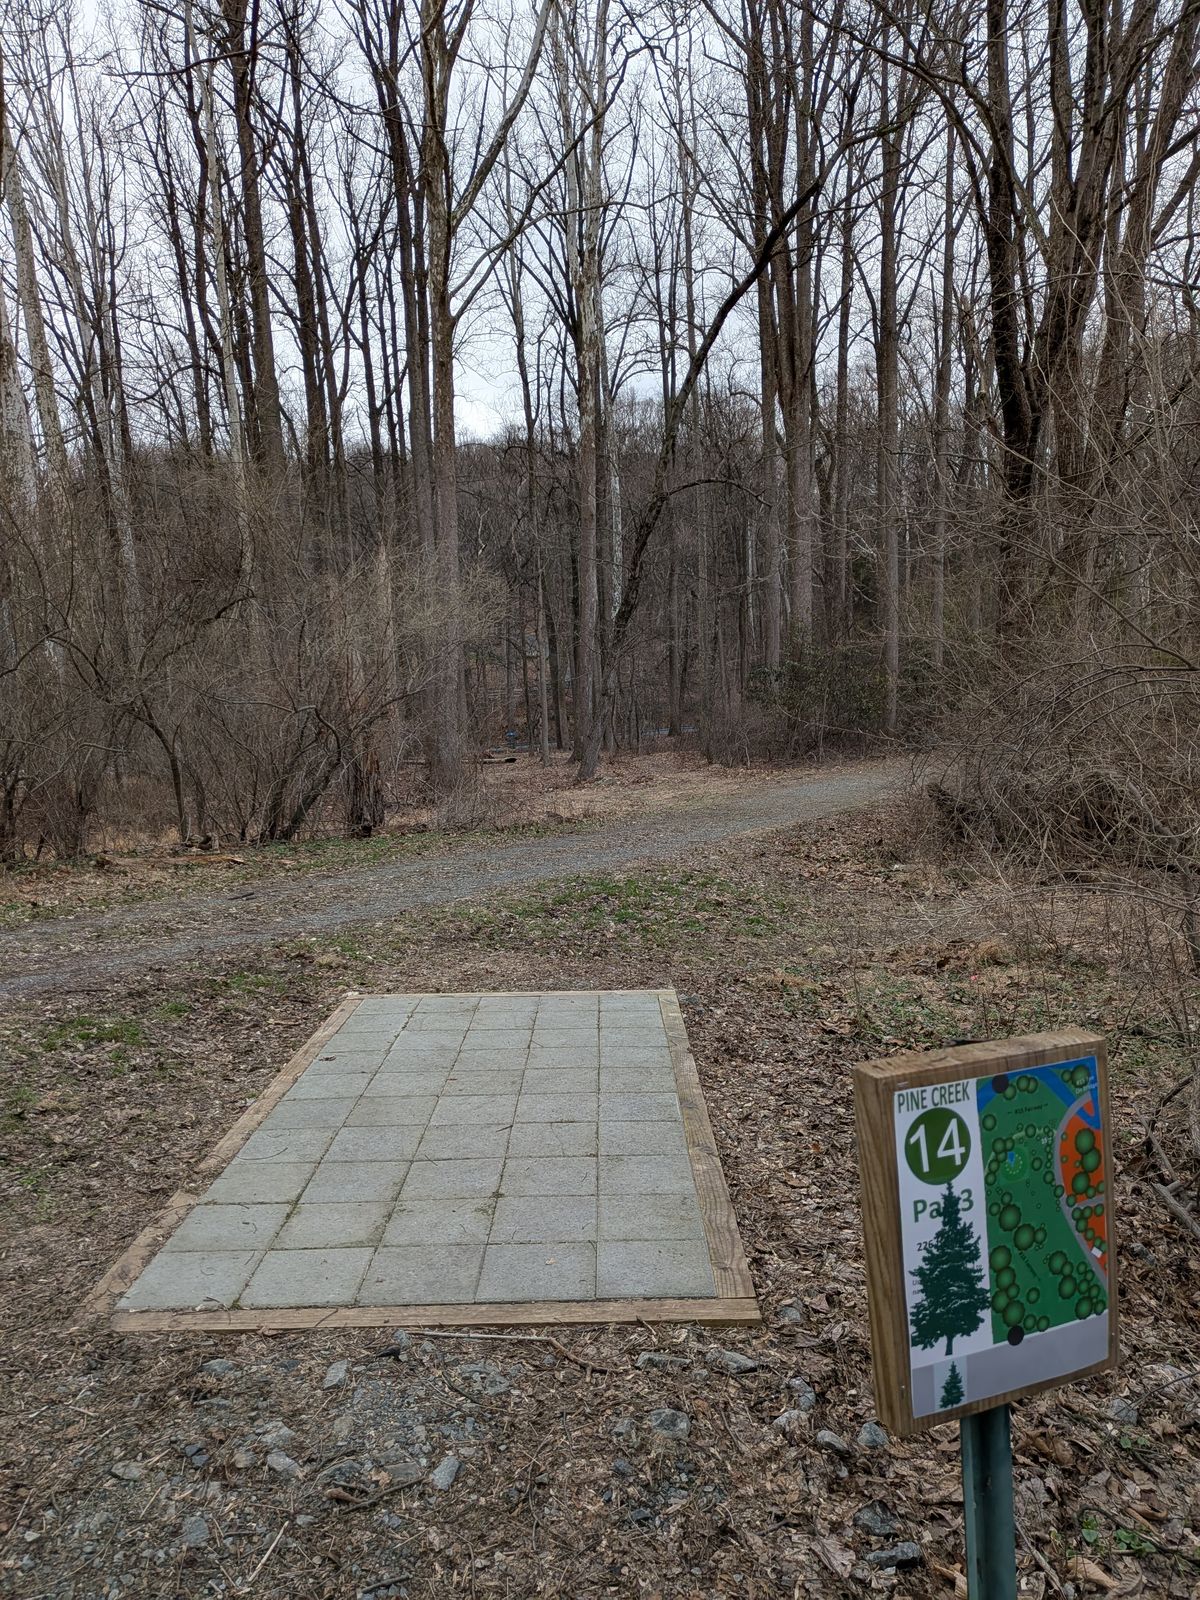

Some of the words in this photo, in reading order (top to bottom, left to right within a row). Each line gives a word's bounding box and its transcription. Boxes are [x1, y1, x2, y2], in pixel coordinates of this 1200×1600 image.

[897, 1088, 928, 1114] PINE
[931, 1081, 970, 1107] CREEK
[909, 1117, 966, 1173] 14
[913, 1199, 948, 1223] Pa
[960, 1188, 974, 1212] 3
